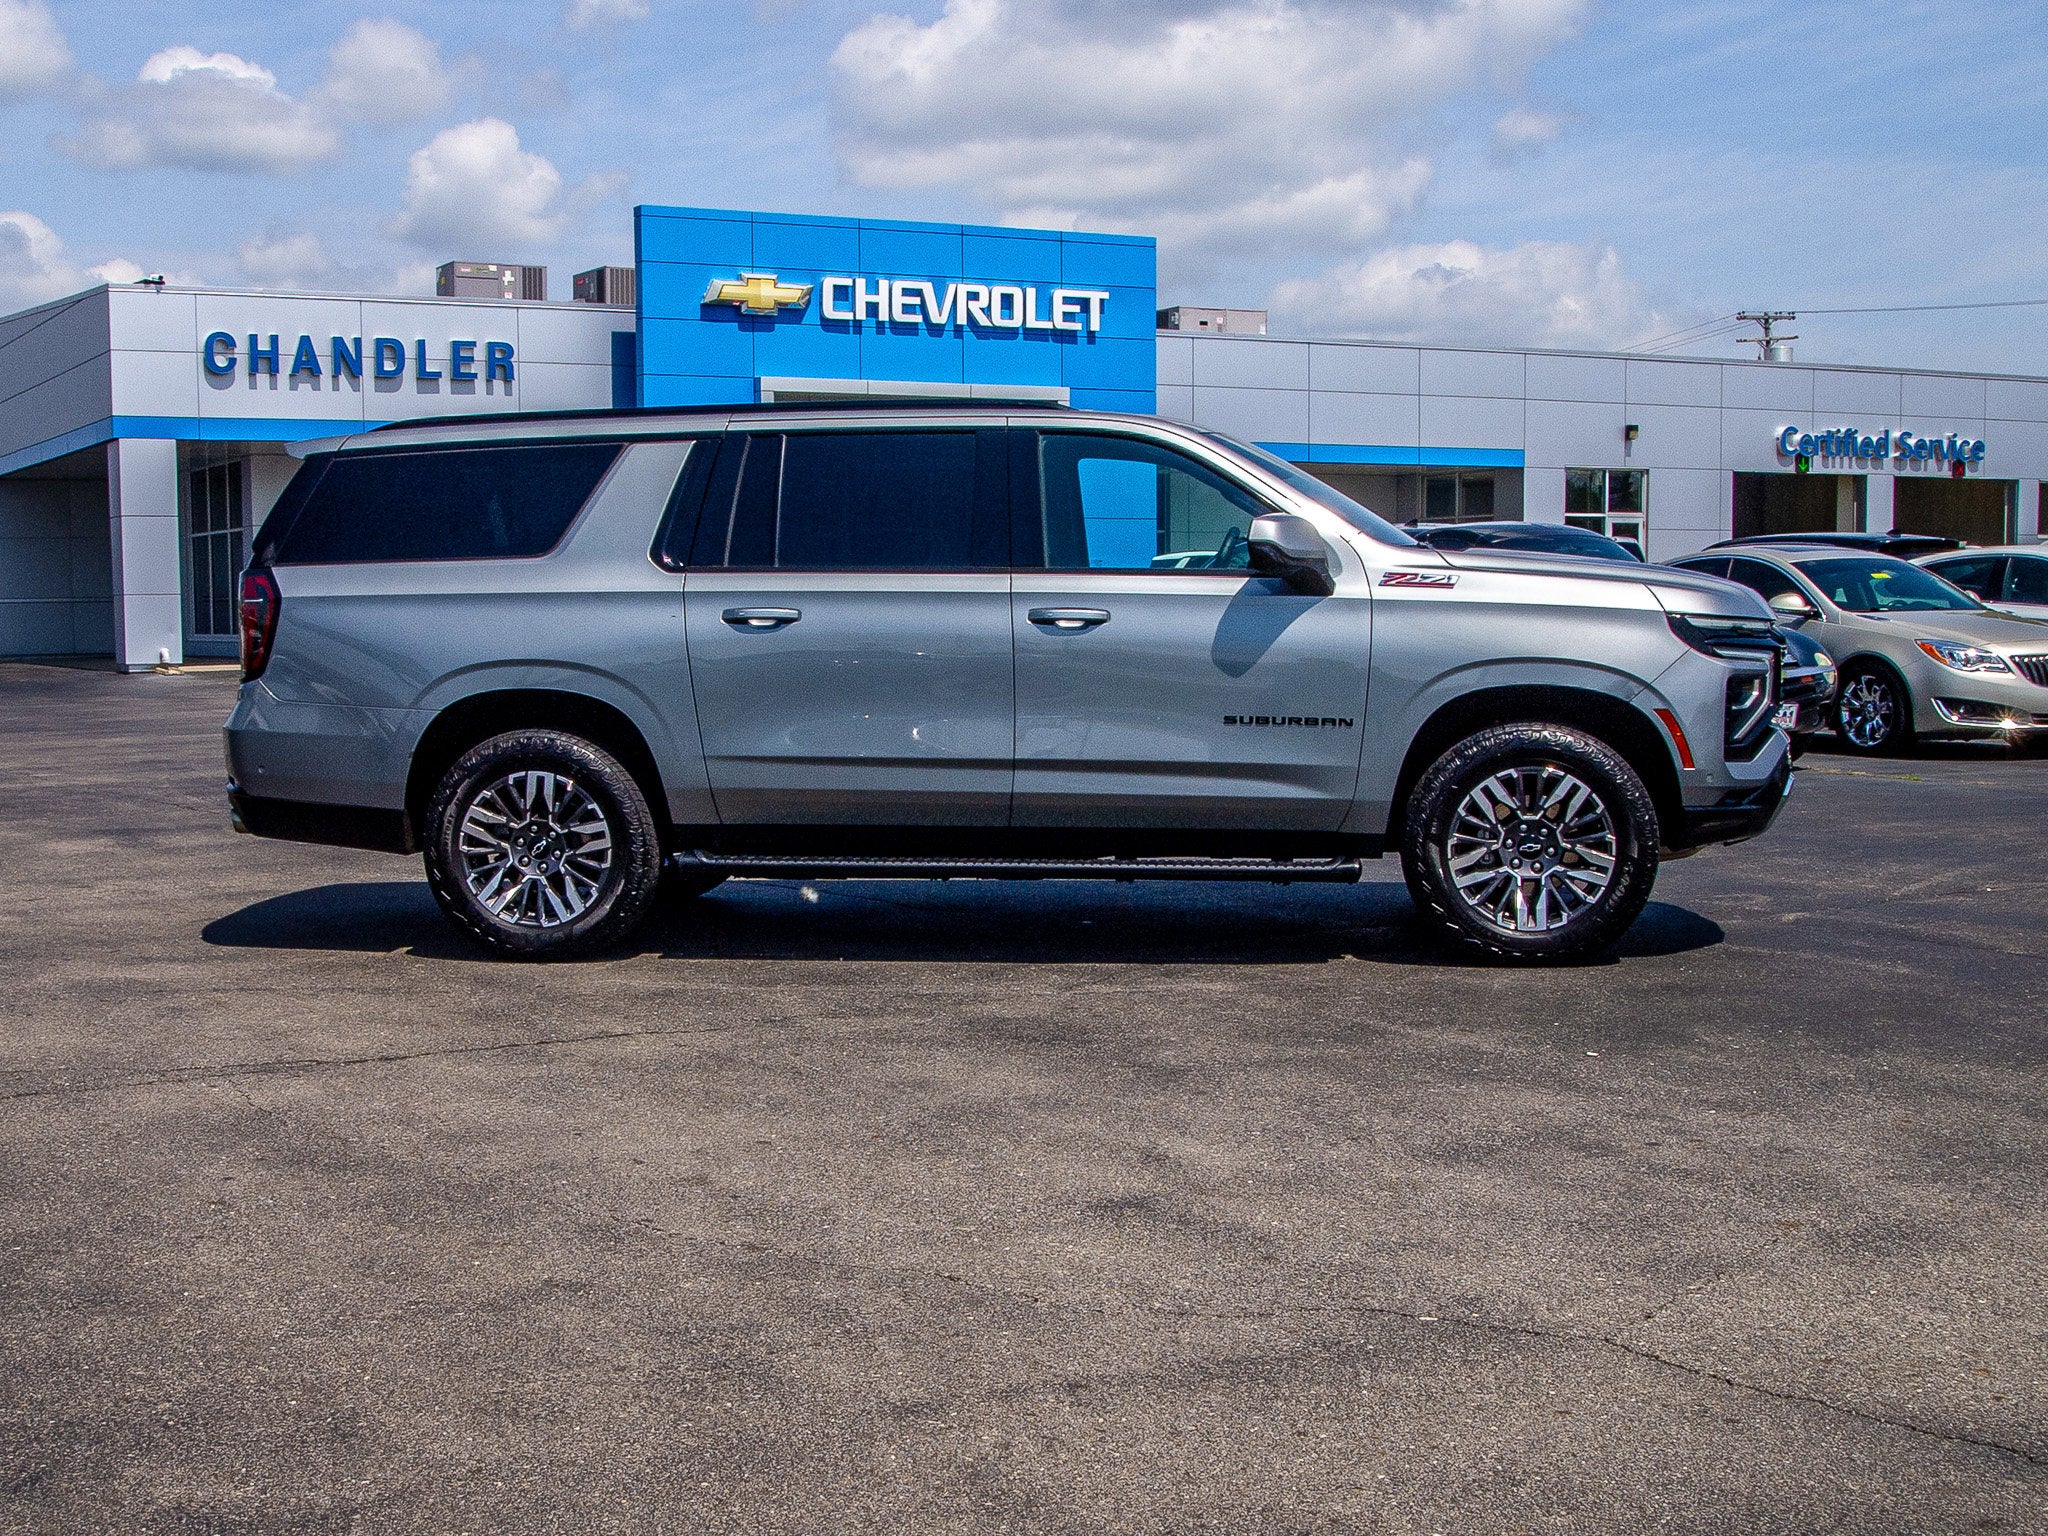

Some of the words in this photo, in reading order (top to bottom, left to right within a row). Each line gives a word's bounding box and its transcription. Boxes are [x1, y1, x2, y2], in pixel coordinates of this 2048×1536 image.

[821, 276, 1110, 332] CHEVROLET
[203, 331, 516, 381] CHANDLER
[1780, 425, 1890, 459] Certified
[1899, 431, 1986, 462] Service
[1378, 571, 1460, 589] Z71
[1222, 715, 1355, 727] SUBURBAN
